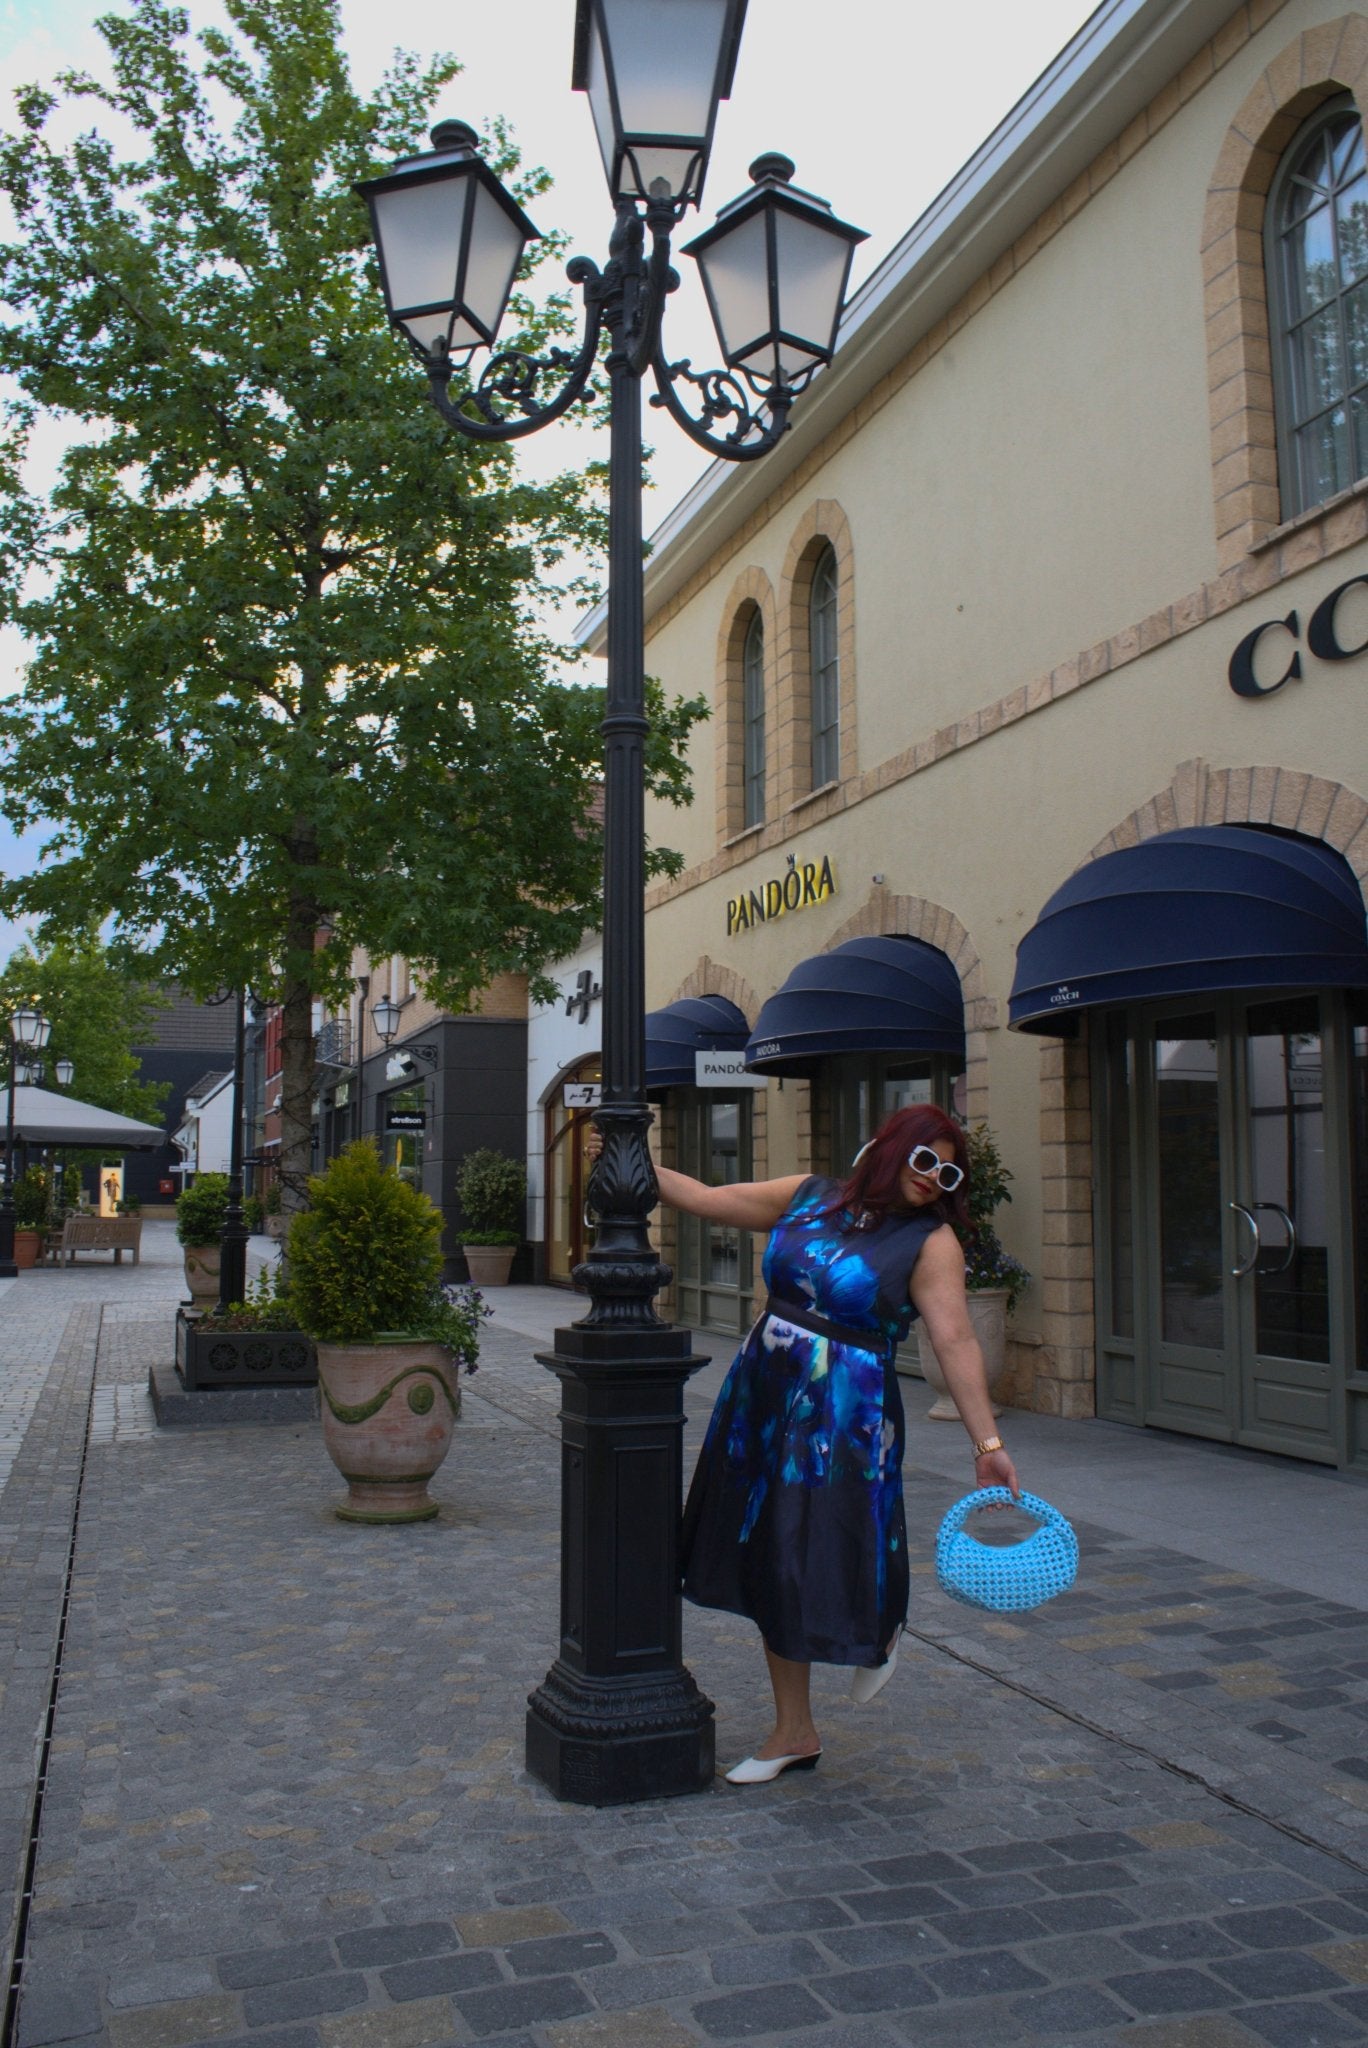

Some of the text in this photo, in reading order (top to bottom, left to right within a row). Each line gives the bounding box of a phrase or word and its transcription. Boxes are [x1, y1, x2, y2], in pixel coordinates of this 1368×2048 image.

[727, 853, 835, 936] PANDORA
[1050, 991, 1080, 1003] COACH
[755, 1042, 781, 1057] PANDORA
[704, 1062, 746, 1074] PANDO
